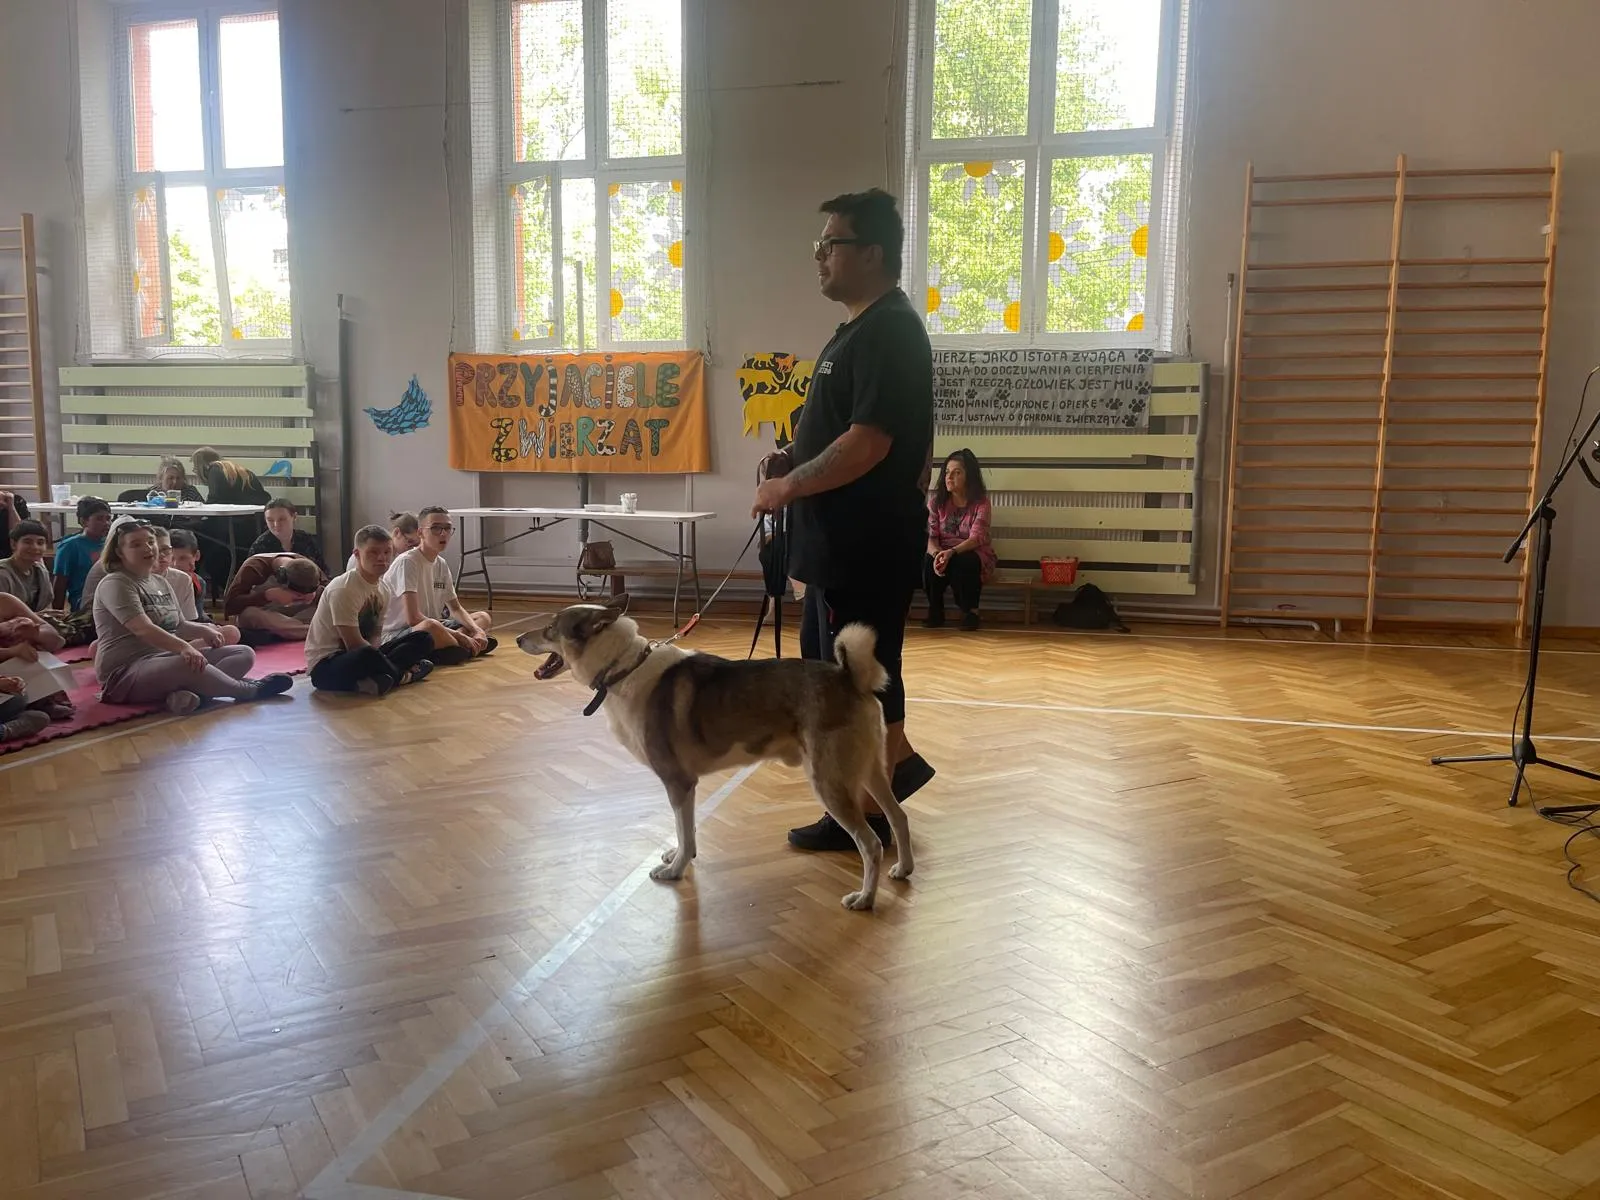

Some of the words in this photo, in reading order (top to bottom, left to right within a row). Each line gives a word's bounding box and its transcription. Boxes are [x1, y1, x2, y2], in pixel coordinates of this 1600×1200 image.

[982, 351, 1018, 363] JAKO
[1023, 351, 1068, 363] ISTOTA
[974, 366, 988, 375] DO
[991, 365, 1071, 376] ODCZUWANIA
[1075, 363, 1145, 376] CIERPIENIA
[939, 378, 965, 387] JEST
[1078, 379, 1112, 390] JEST
[1114, 379, 1133, 390] MU
[968, 413, 1005, 422] USTAWY
[1008, 413, 1015, 421] O
[1018, 413, 1062, 423] OCHRONIE
